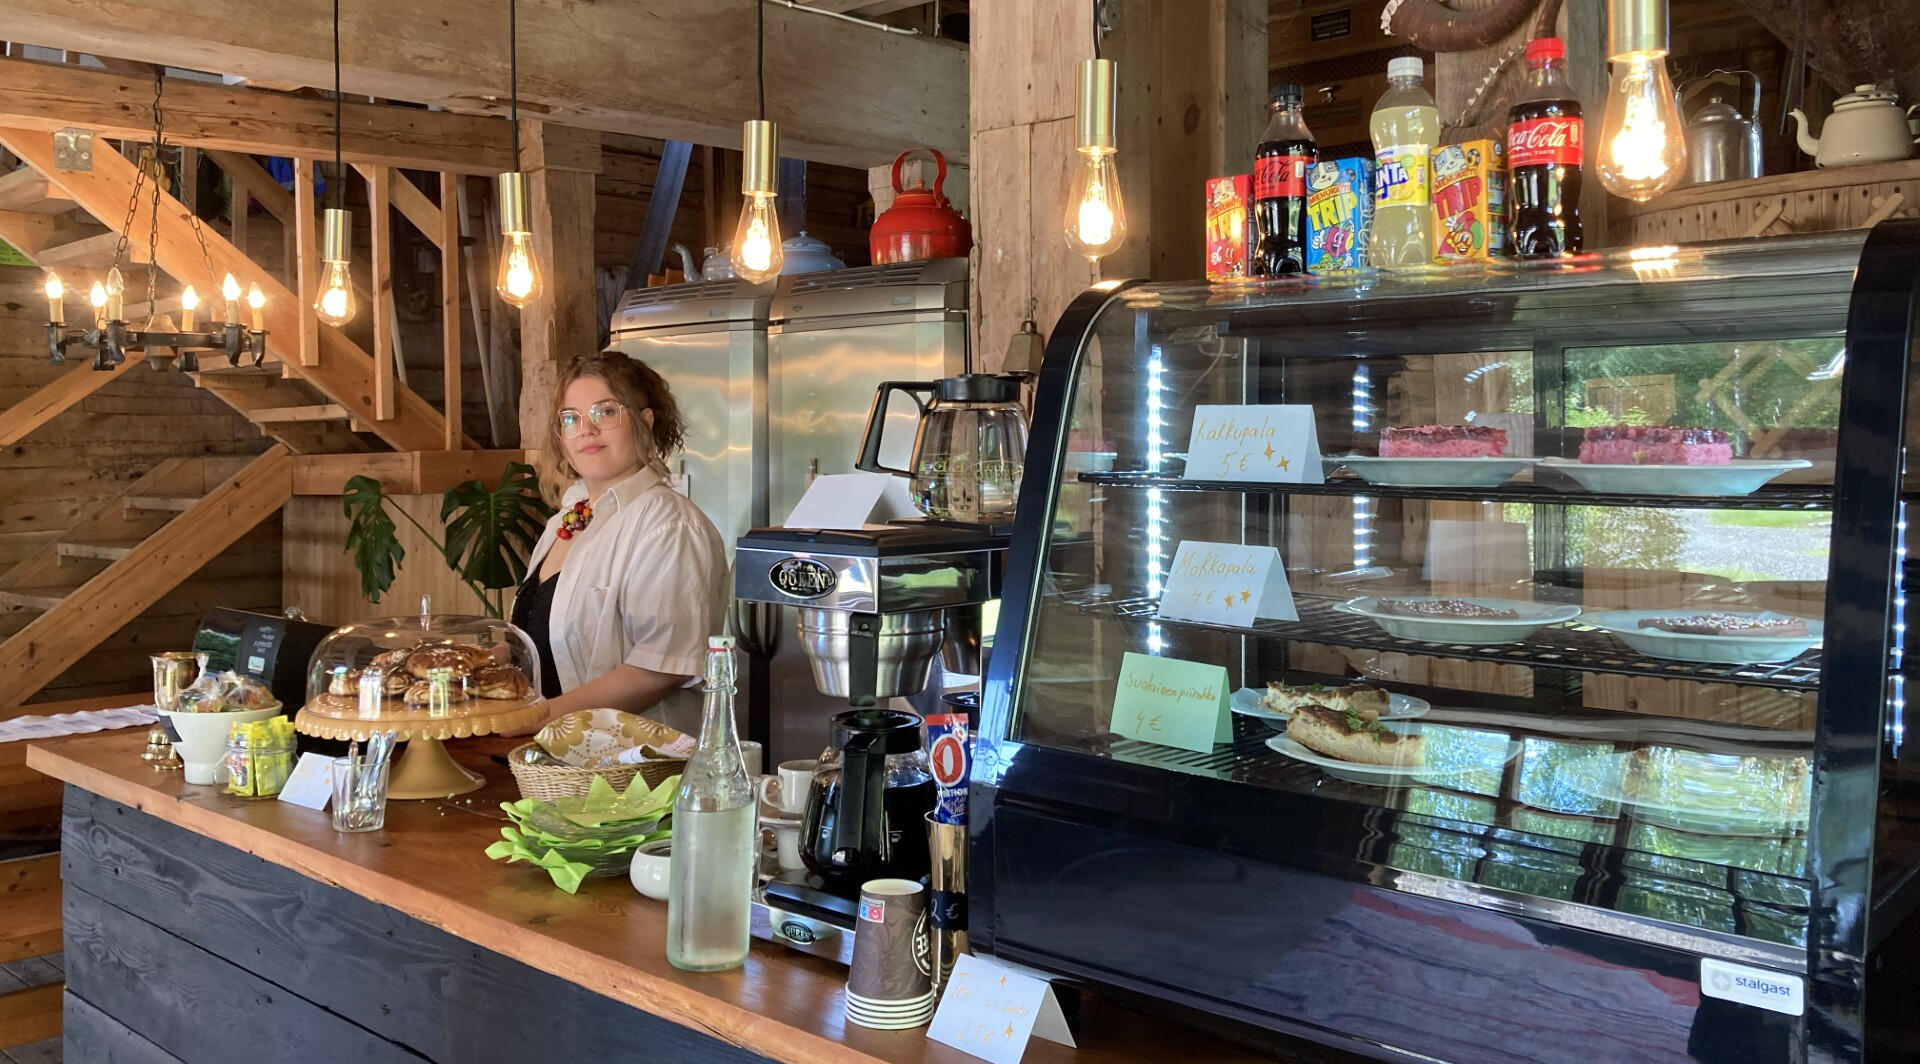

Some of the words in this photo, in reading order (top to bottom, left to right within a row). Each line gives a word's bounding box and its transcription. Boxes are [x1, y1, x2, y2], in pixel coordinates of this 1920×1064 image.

[1375, 161, 1409, 194] ANTA
[1307, 192, 1357, 232] TRIP
[1433, 176, 1482, 220] TRIP
[1207, 207, 1246, 245] TRP
[1195, 416, 1275, 447] Kakkupala
[1735, 976, 1792, 997] stalgast
